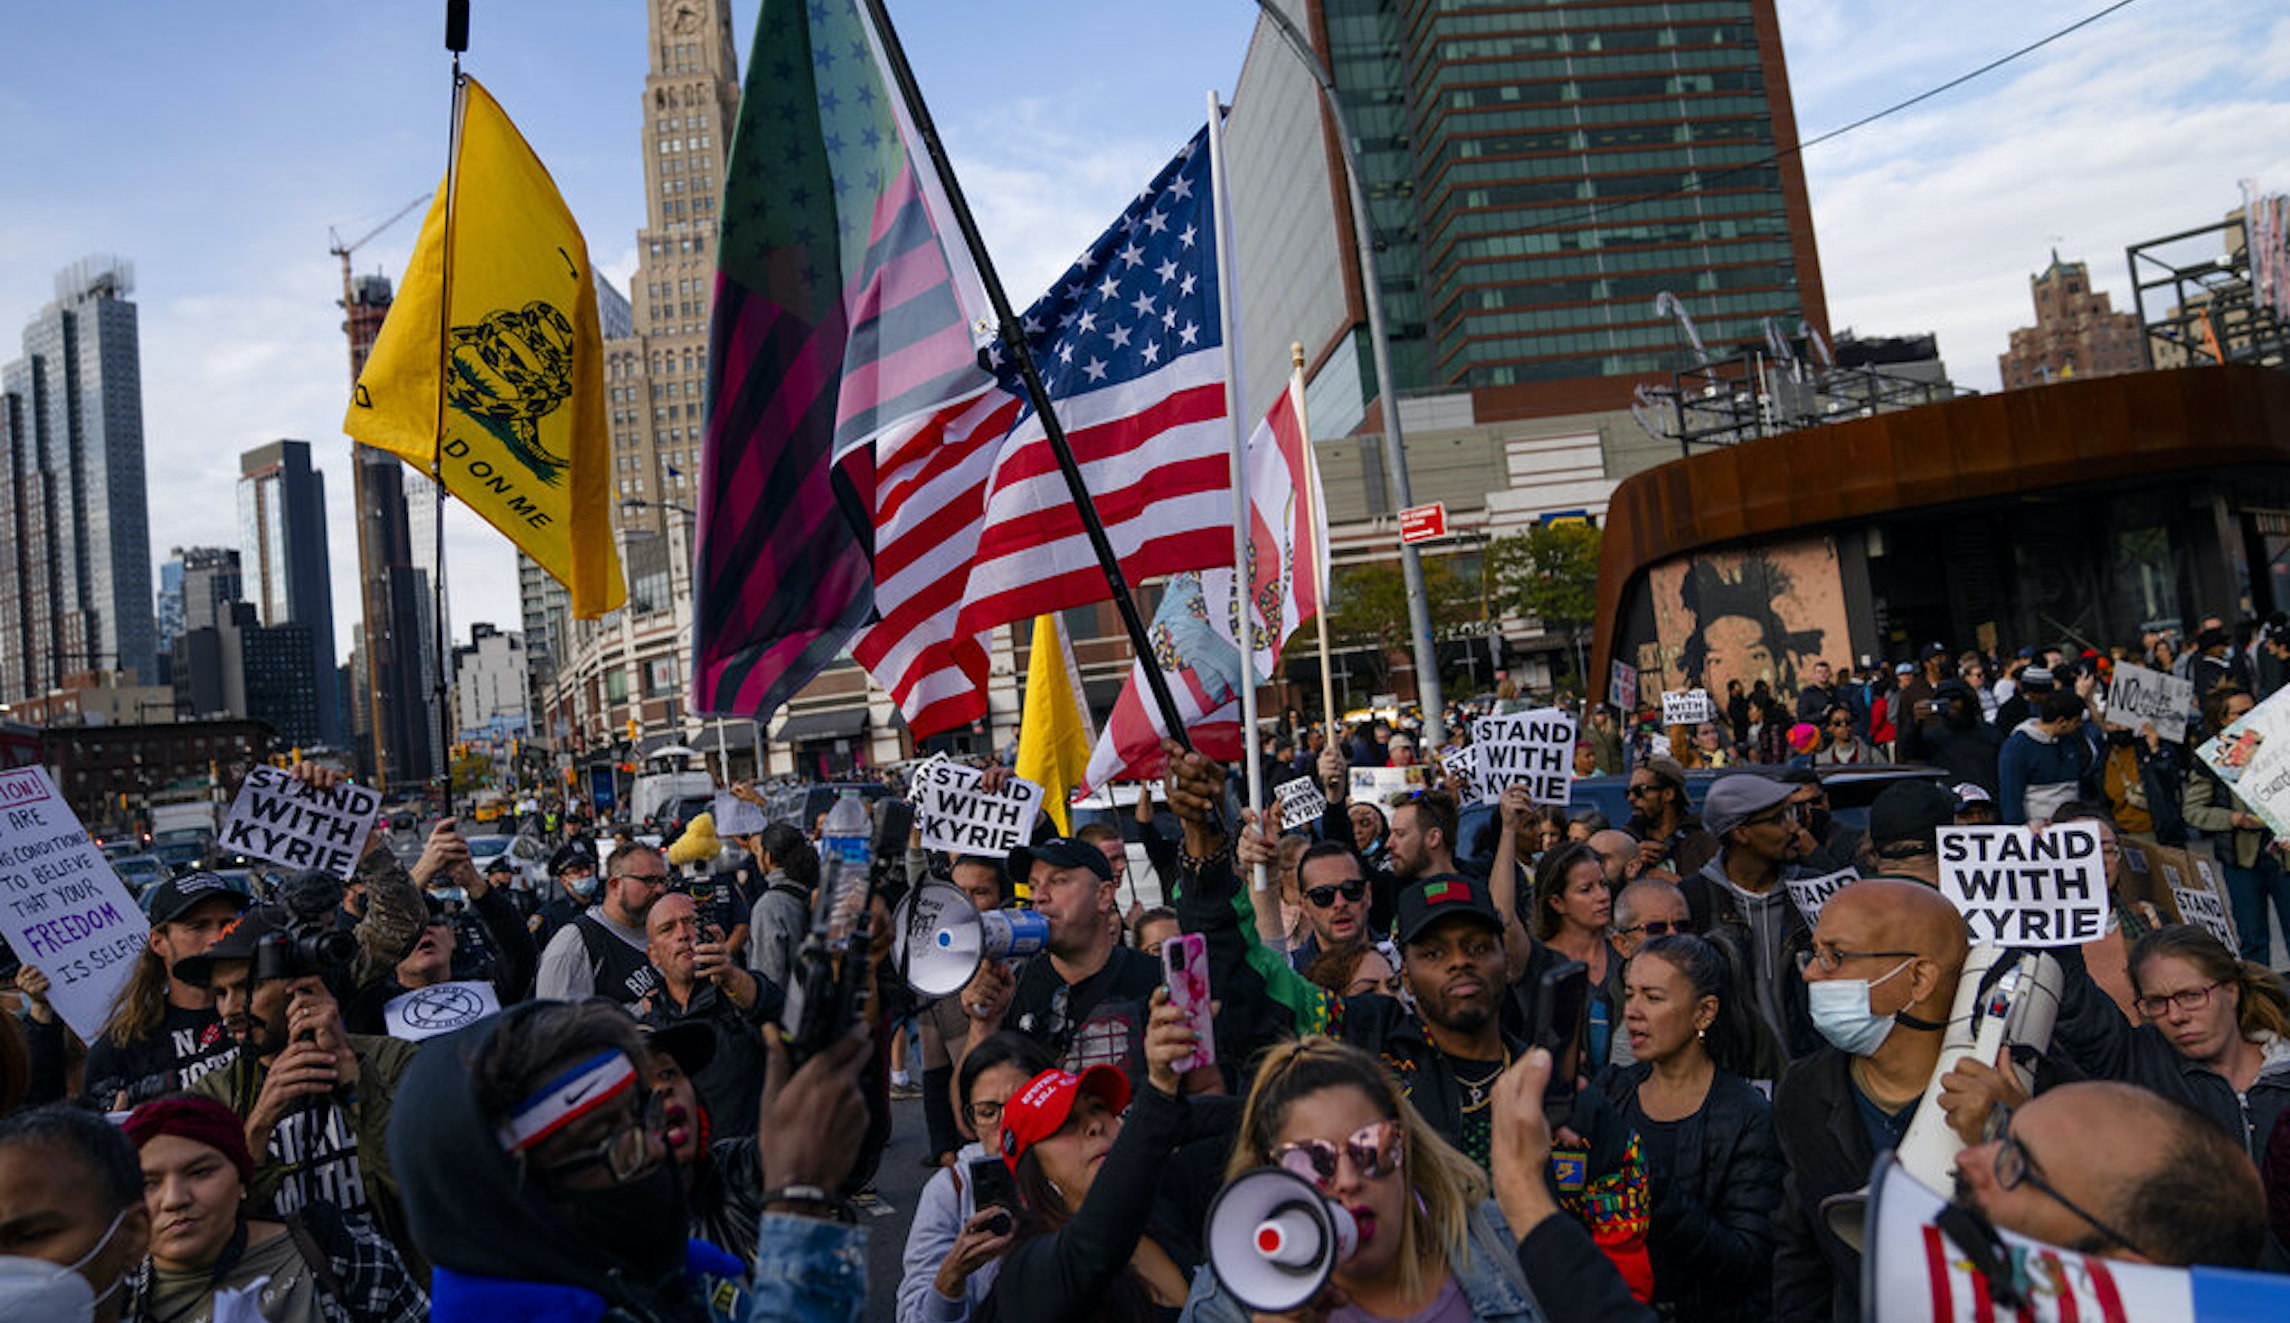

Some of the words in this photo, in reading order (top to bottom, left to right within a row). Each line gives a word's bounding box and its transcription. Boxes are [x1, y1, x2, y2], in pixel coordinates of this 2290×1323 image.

[469, 461, 513, 494] ON
[507, 495, 553, 530] ME
[1668, 701, 1702, 711] WITH
[1482, 720, 1571, 743] STAND
[1487, 745, 1562, 771] WITH
[250, 770, 374, 816] STAND
[938, 790, 1020, 826] WITH
[1283, 790, 1318, 810] WITH
[8, 807, 48, 831] ARE
[252, 792, 357, 845] WITH
[926, 815, 1019, 851] KYRIE
[228, 819, 353, 876] KYRIE
[1943, 830, 2095, 862] STAND
[0, 874, 29, 894] TO
[33, 852, 94, 886] BELIEVE
[1954, 867, 2089, 901] WITH
[10, 891, 50, 918] THAT
[52, 878, 104, 906] YOUR
[22, 900, 125, 958] FREEDOM
[56, 958, 92, 985] IS
